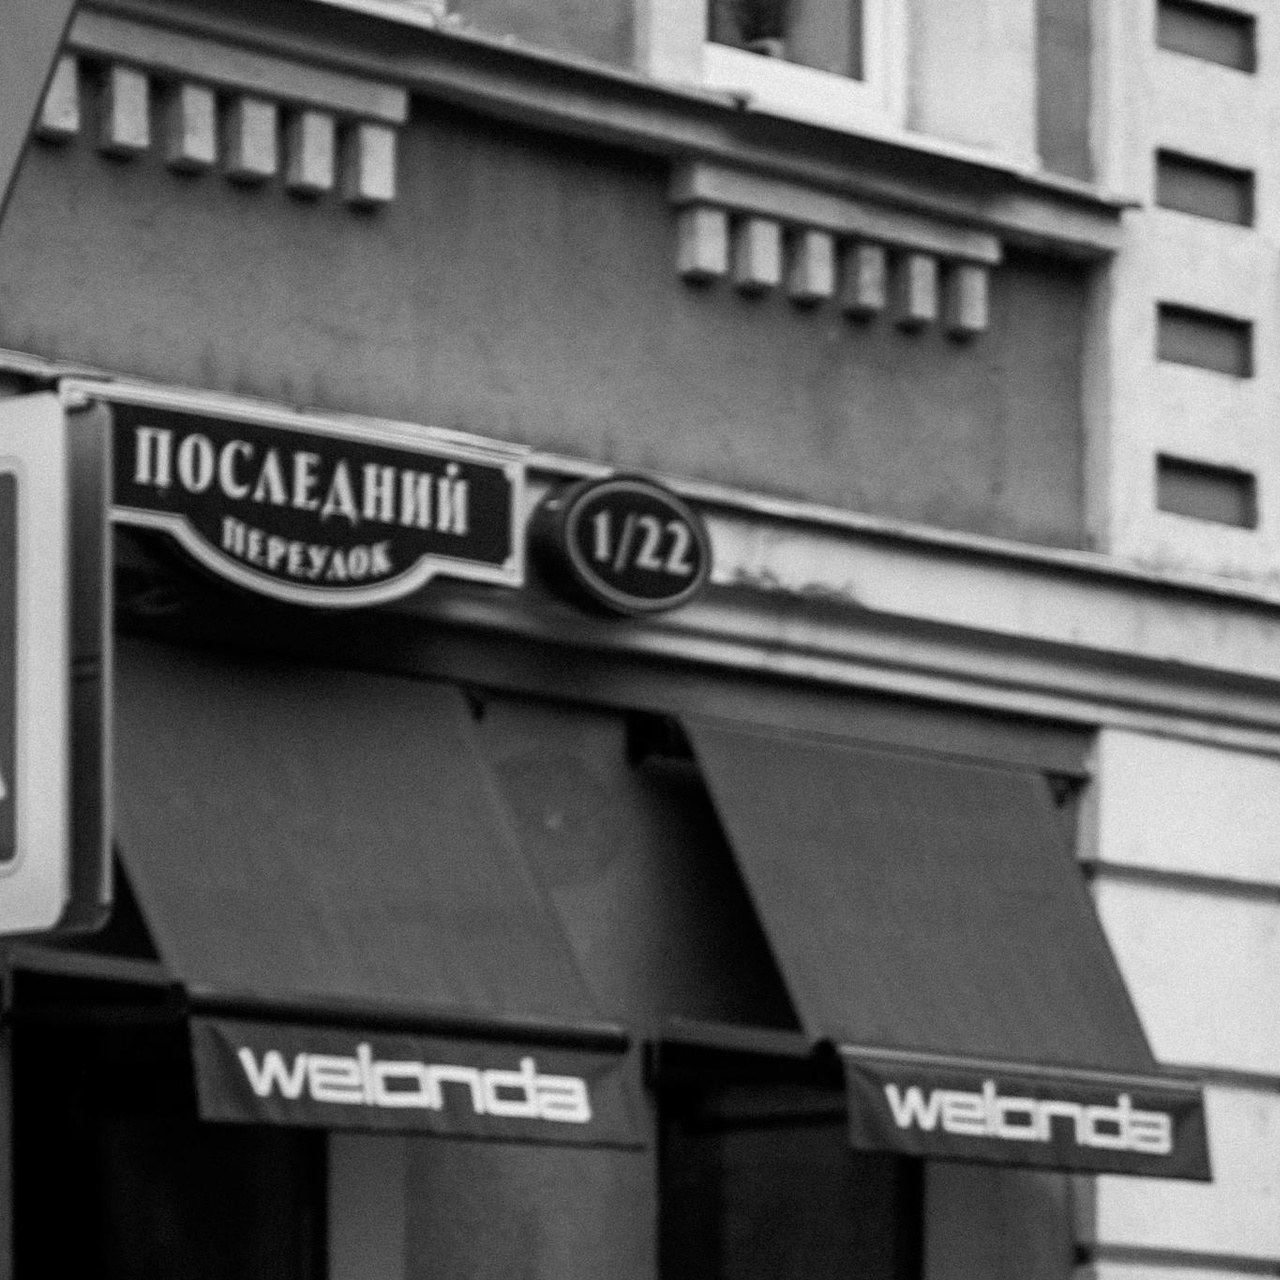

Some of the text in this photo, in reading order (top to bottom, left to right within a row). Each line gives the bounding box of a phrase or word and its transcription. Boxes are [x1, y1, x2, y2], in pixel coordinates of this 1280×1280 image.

[134, 426, 468, 536] ПОСЛЕДНИЙ
[222, 515, 393, 581] ПЕРЕУЛОК
[594, 509, 691, 575] 1/22
[238, 1042, 592, 1124] welonda
[885, 1079, 1173, 1156] welonda
